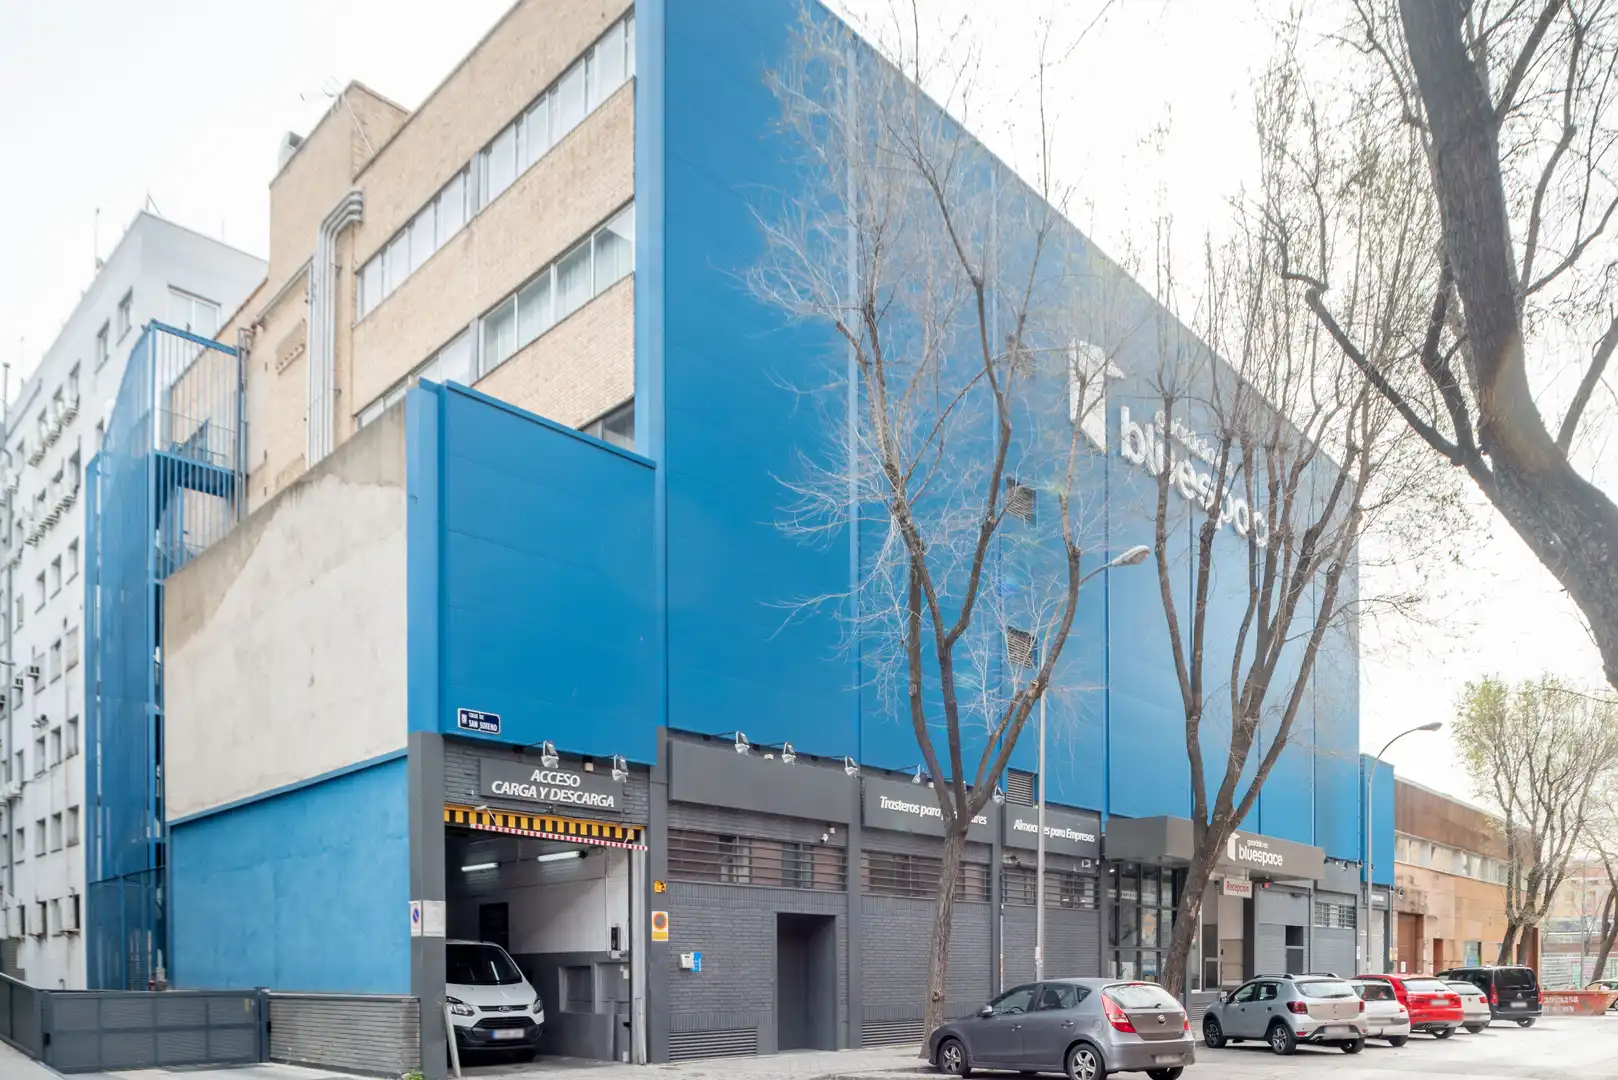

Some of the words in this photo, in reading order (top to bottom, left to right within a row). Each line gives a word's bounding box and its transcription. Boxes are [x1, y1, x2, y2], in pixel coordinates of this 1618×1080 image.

[1120, 405, 1278, 550] bluespac
[469, 720, 478, 728] SAN
[530, 769, 581, 787] ACCESO
[491, 781, 537, 798] CARGA
[539, 787, 549, 800] Y
[549, 788, 615, 808] DESCARGA
[880, 796, 920, 814] Trasteros
[920, 805, 941, 817] para
[1013, 819, 1051, 835] Almacees
[1050, 828, 1066, 838] para
[1066, 828, 1095, 842] Empresas
[1238, 844, 1283, 867] bluespace
